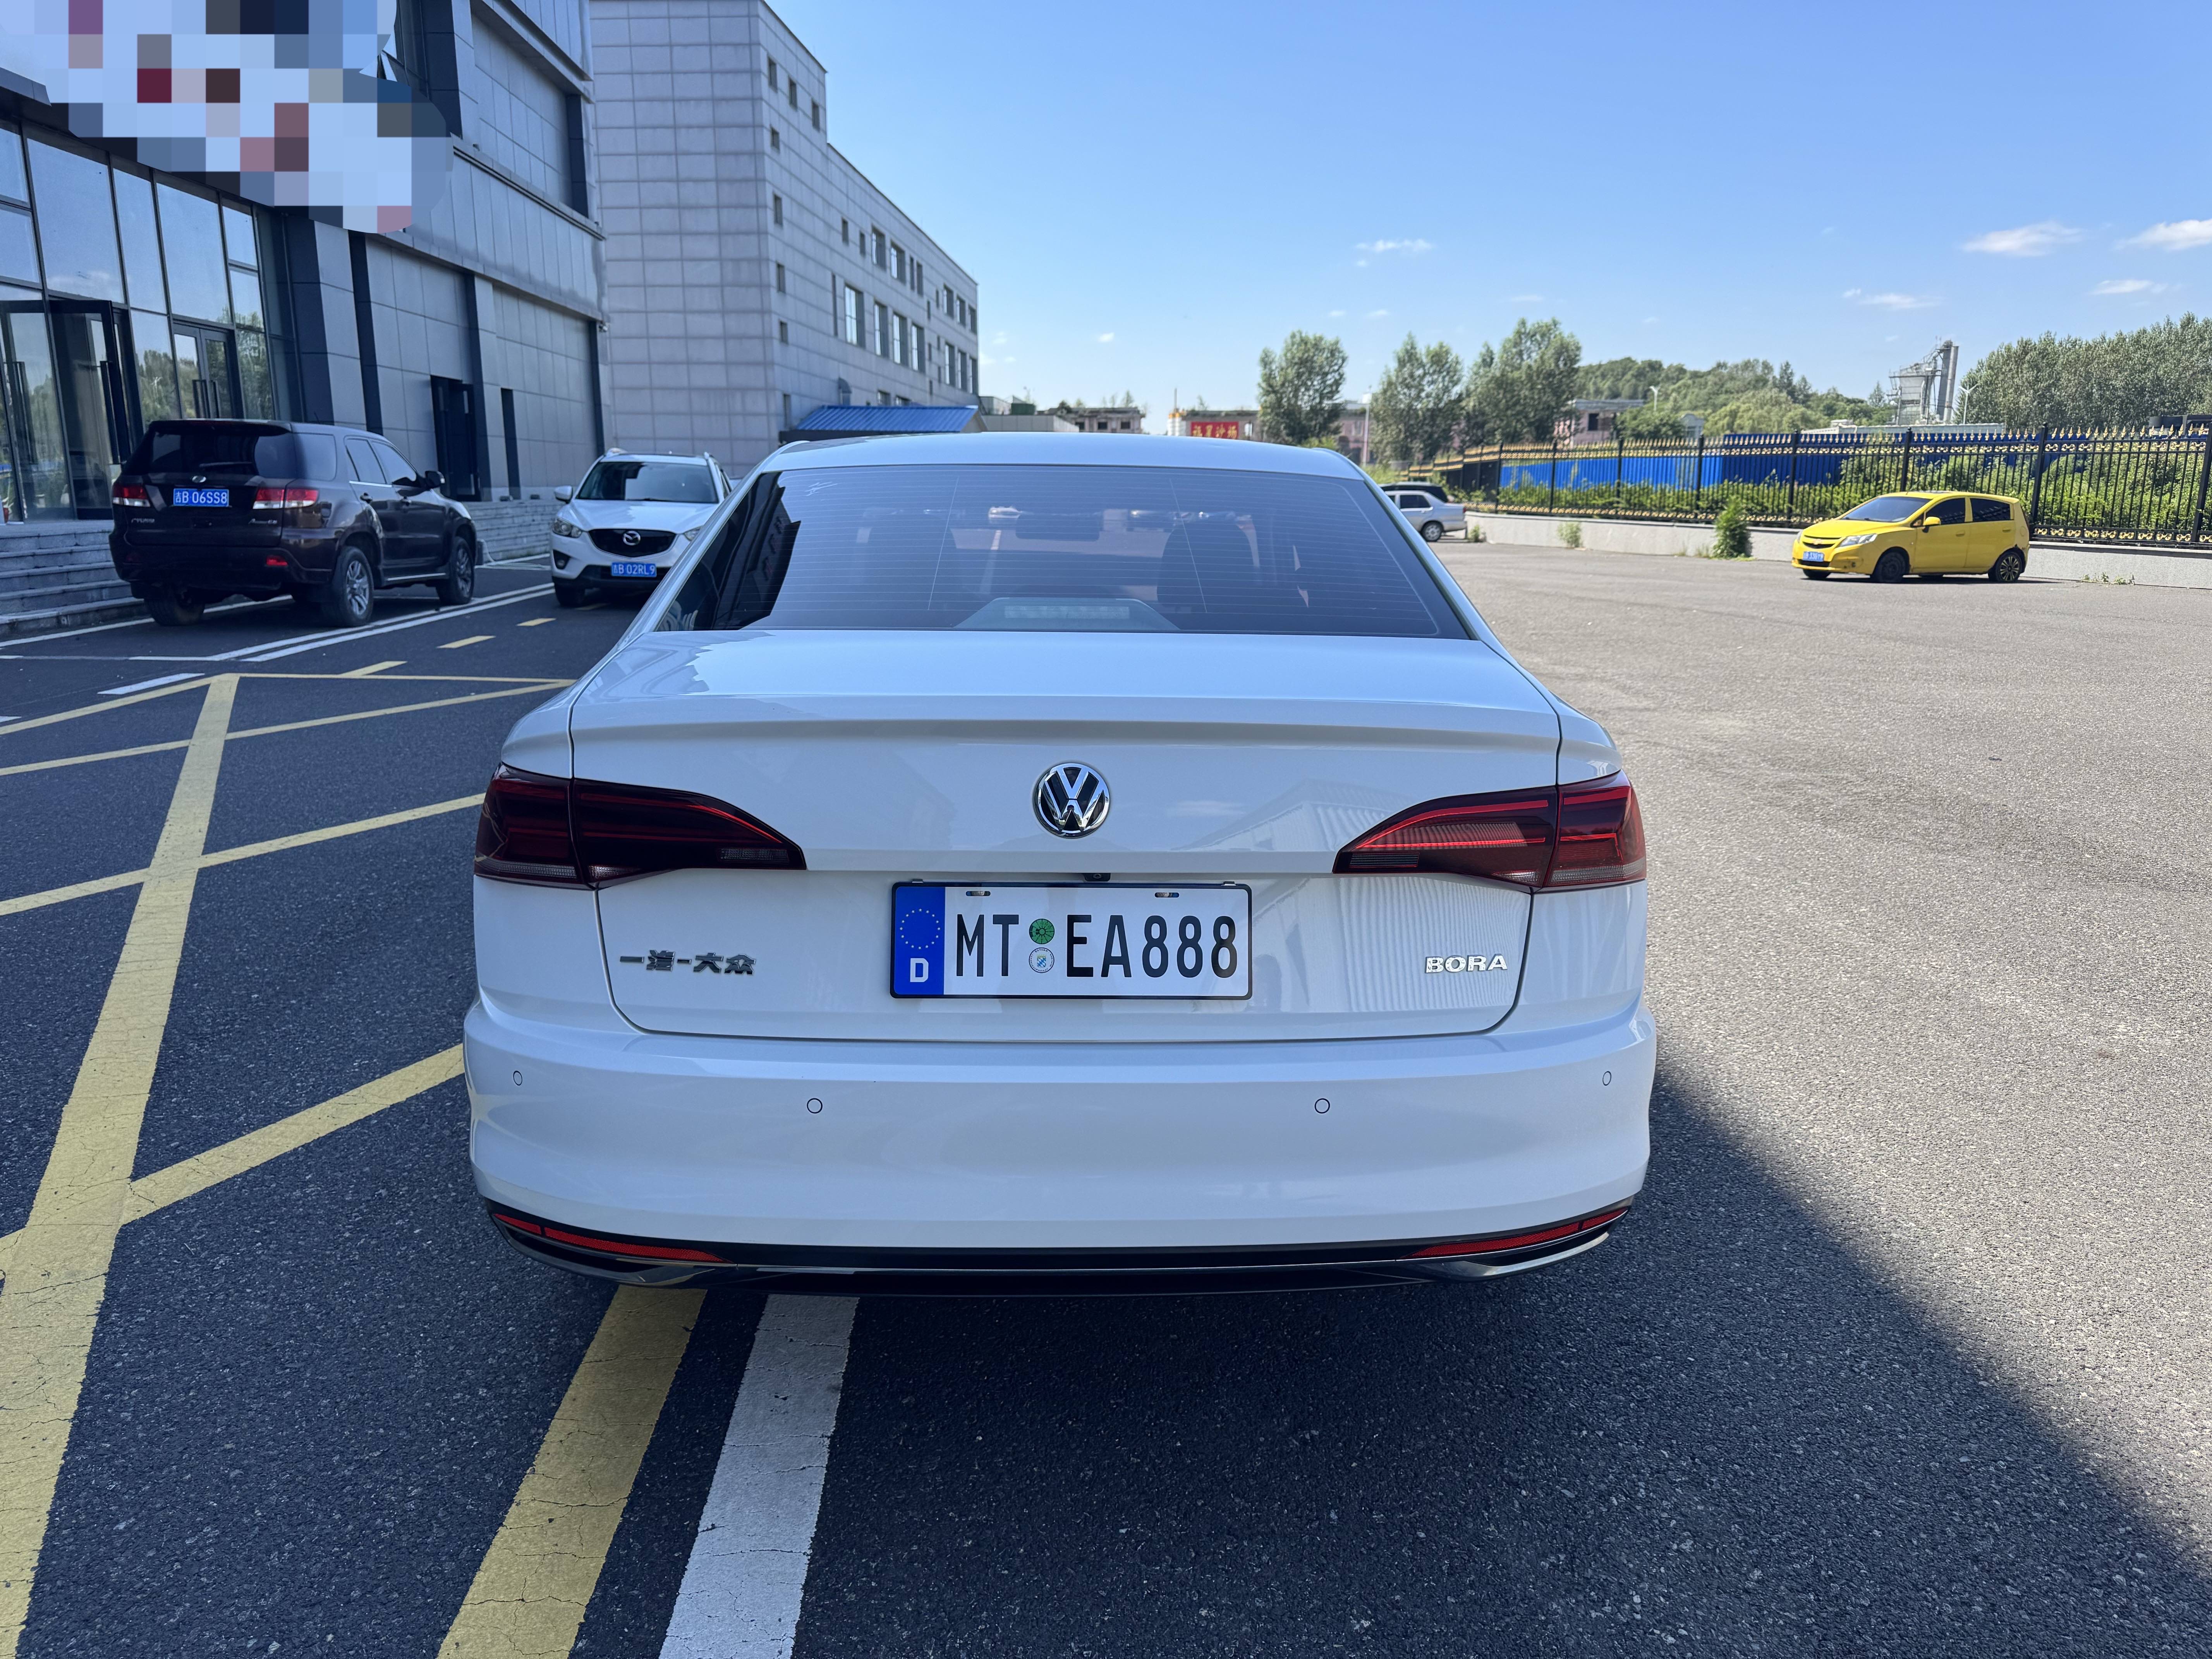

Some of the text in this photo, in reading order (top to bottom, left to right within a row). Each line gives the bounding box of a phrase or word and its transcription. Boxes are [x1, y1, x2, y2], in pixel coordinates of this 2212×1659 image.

[956, 914, 1236, 978] MT EA888
[910, 958, 929, 982] D
[1425, 954, 1508, 973] BORA
